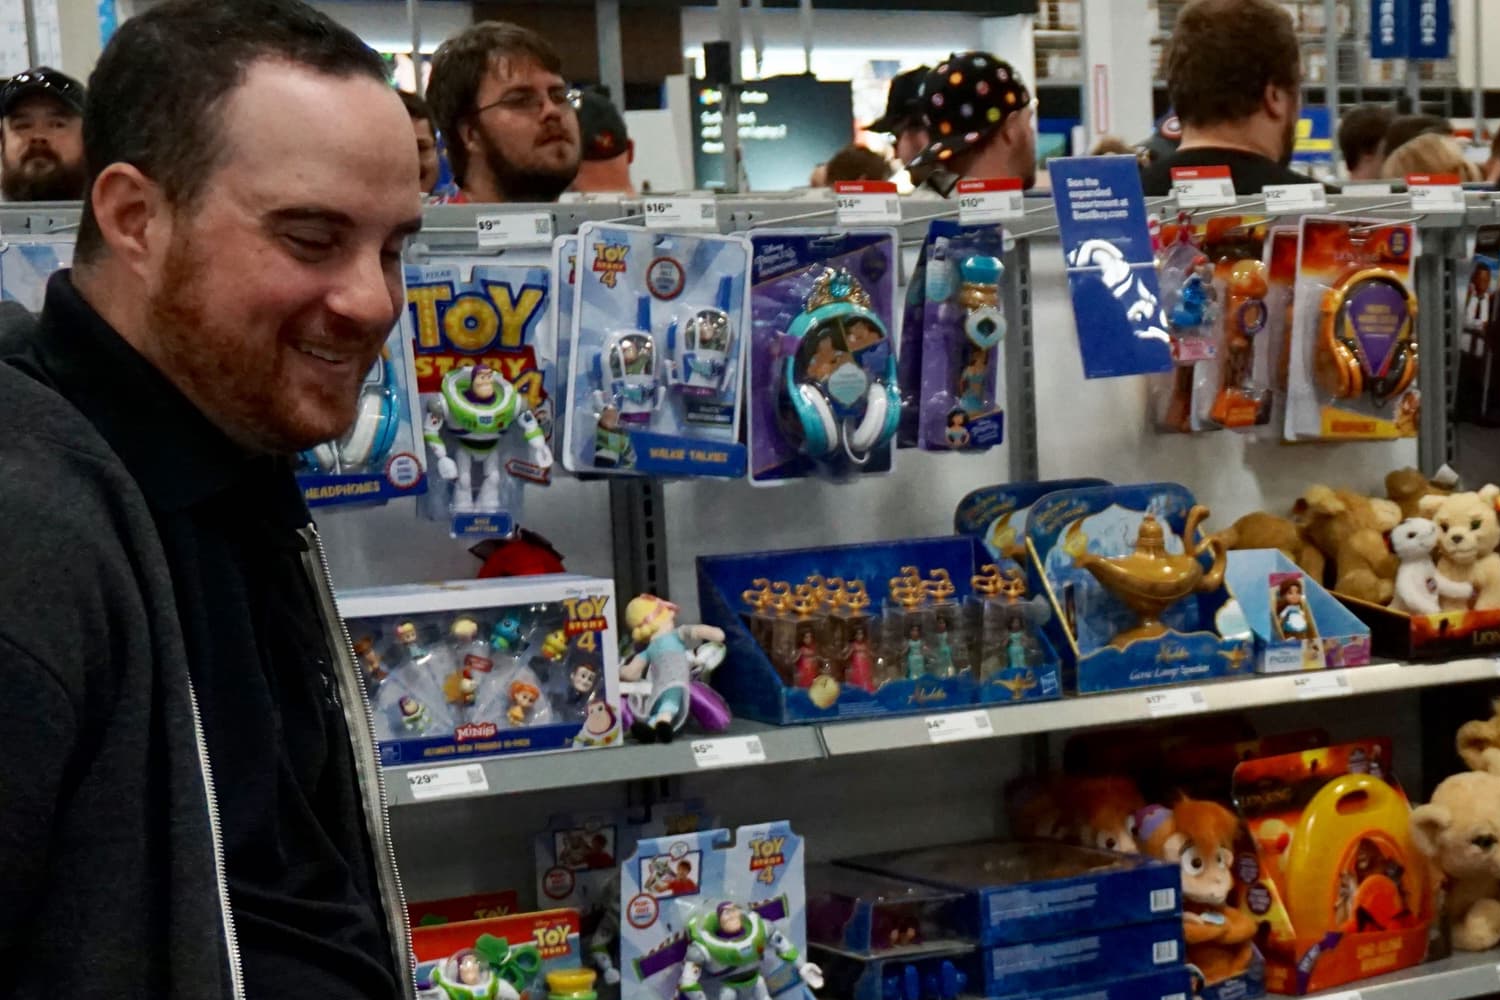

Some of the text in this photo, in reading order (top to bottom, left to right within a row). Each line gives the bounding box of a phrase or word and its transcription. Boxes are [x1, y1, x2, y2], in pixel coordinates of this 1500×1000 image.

[593, 242, 631, 261] TOY
[600, 270, 618, 289] 4
[405, 281, 547, 353] TOY
[305, 481, 381, 499] HEADPHONES
[563, 595, 609, 620] TOY
[576, 630, 596, 652] 4
[751, 838, 784, 856] TOY
[758, 867, 775, 885] 4
[533, 925, 571, 946] TOY
